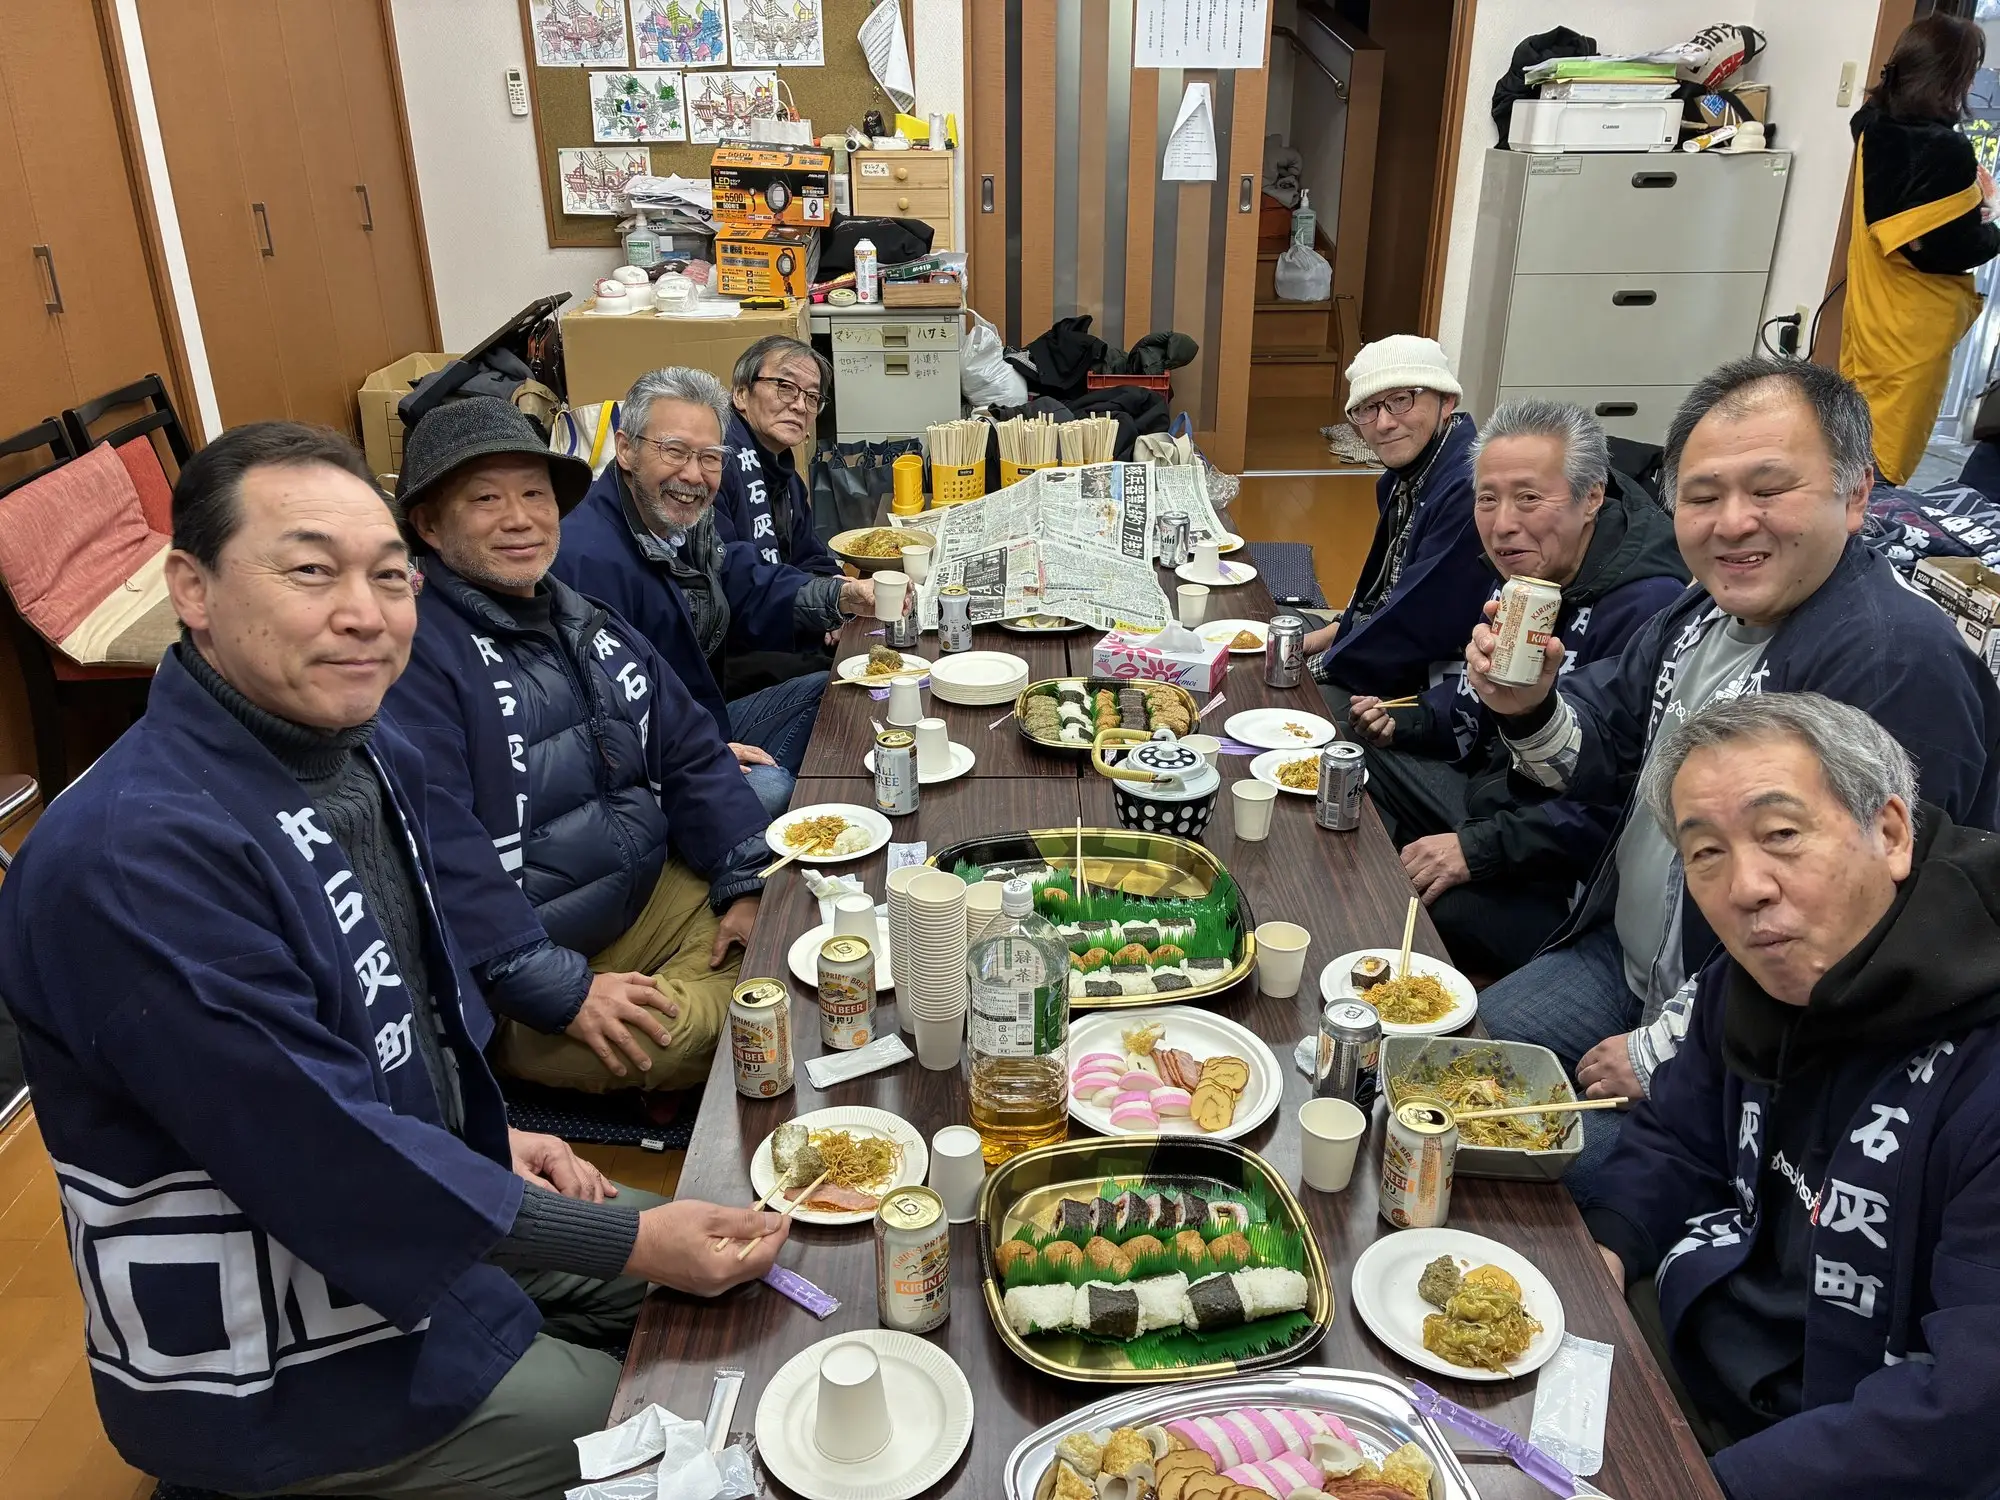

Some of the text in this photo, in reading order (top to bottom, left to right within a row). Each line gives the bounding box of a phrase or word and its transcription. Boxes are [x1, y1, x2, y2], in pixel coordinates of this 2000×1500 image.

[714, 177, 730, 185] LED
[724, 192, 744, 202] 5500
[917, 326, 947, 339] ハサミ
[275, 807, 413, 1074] 本石灰町
[850, 977, 868, 992] BREW
[838, 1002, 864, 1014] BEER
[900, 1278, 937, 1293] KIRIN
